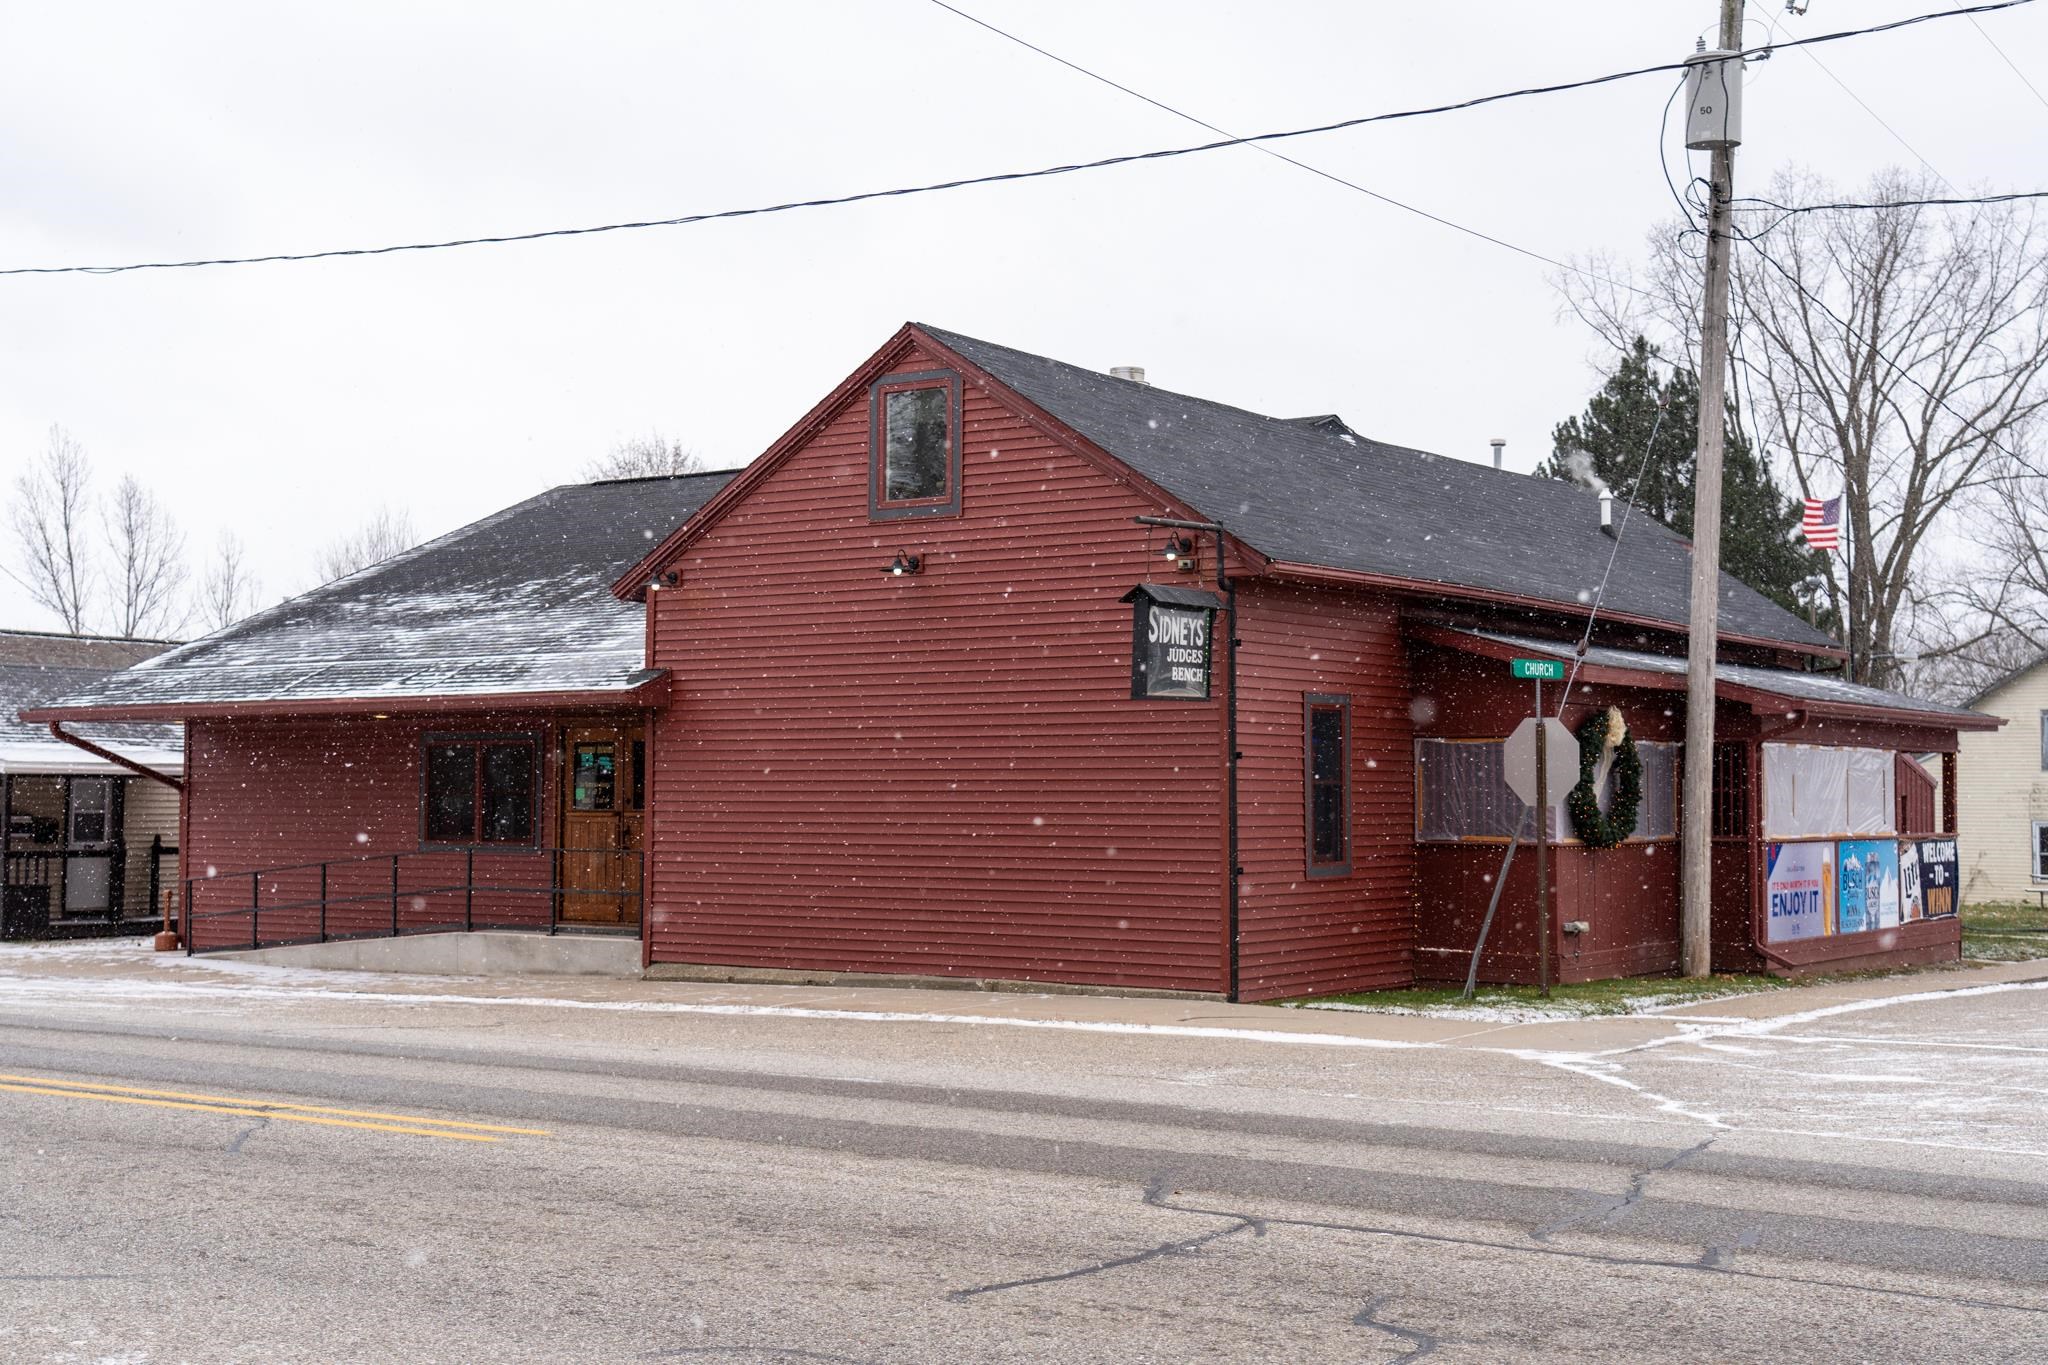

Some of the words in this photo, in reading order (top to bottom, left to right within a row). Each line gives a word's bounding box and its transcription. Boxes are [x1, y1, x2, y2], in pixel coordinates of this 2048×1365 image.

[1700, 106, 1712, 115] 50
[1148, 605, 1204, 647] SIDNEYS
[1167, 648, 1203, 664] JUDGES
[1171, 666, 1203, 682] BENCH
[1524, 662, 1554, 676] CHURCH
[1922, 841, 1955, 863] WELCOME
[1772, 891, 1807, 917] ENJOY
[1810, 890, 1818, 913] IT
[1927, 887, 1952, 915] WINN
